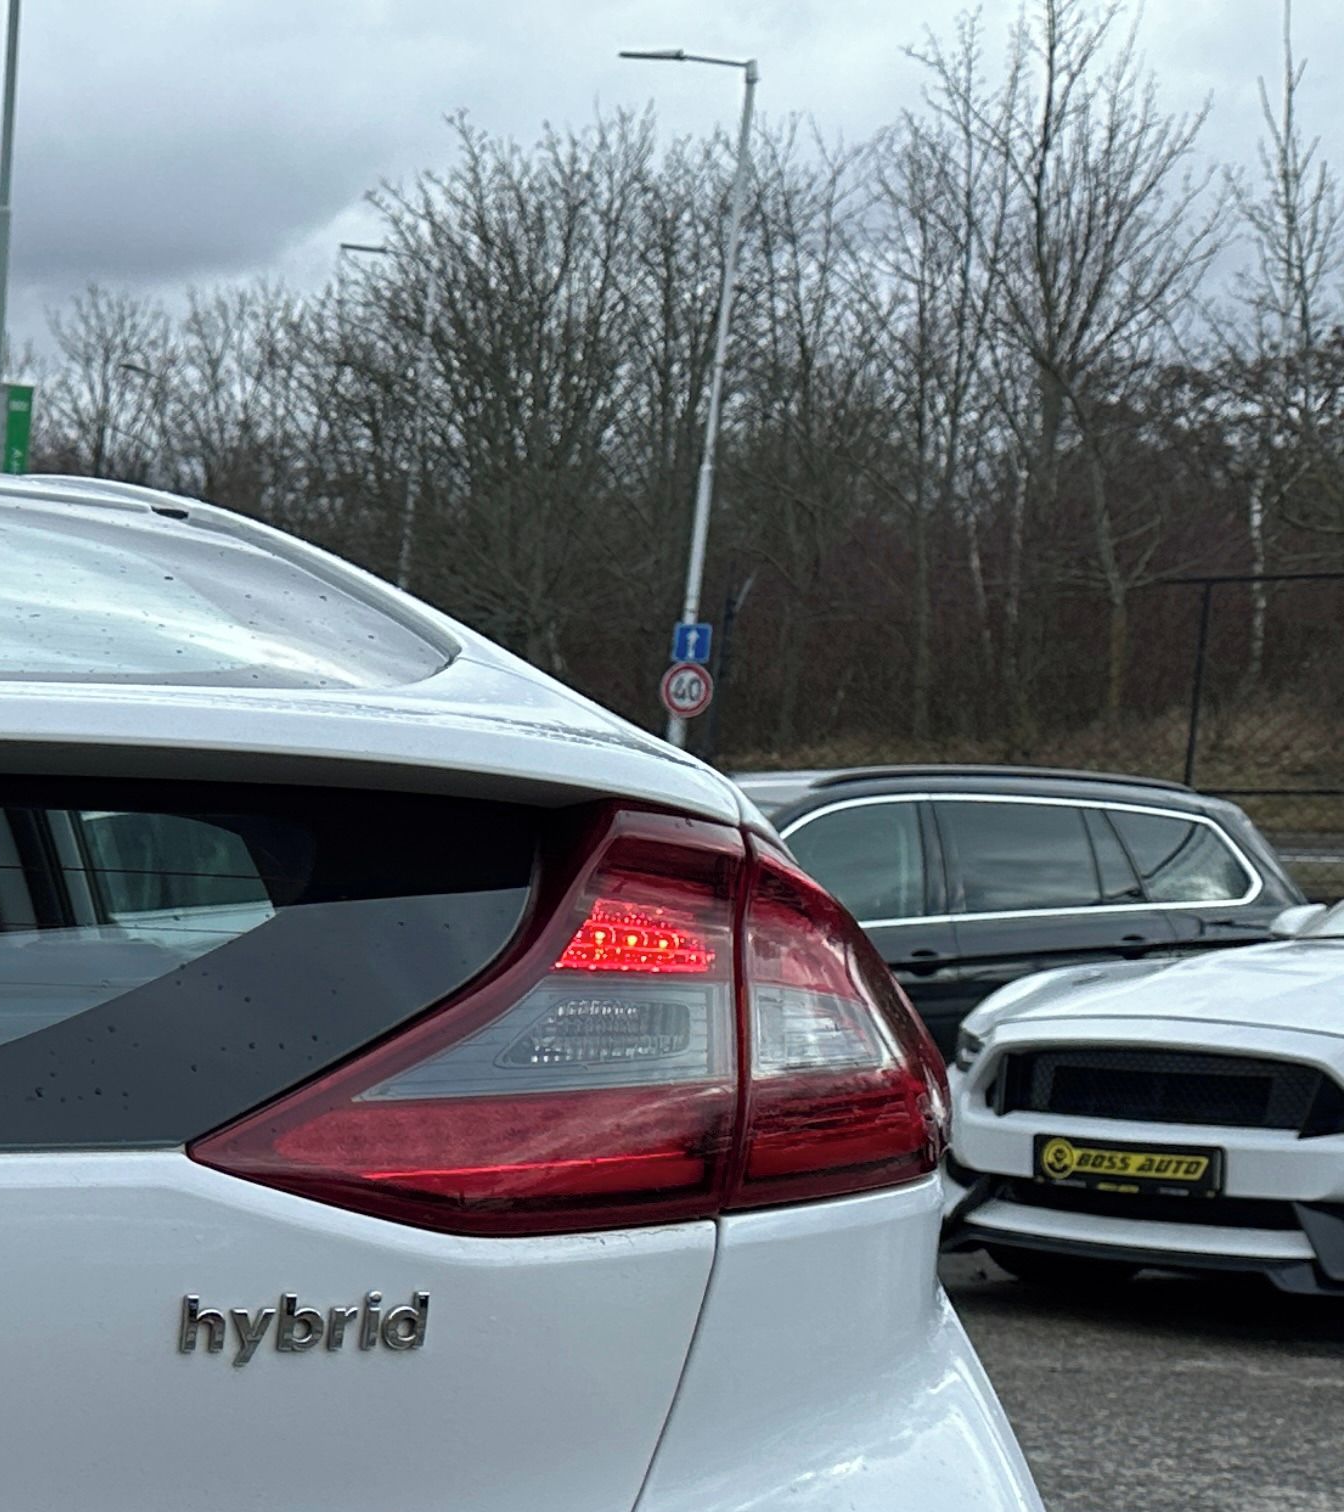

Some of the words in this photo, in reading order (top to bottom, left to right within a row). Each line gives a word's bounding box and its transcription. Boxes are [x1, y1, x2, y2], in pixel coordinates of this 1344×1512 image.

[673, 677, 701, 701] 40
[1077, 1153, 1131, 1170] BOSS
[1136, 1156, 1203, 1175] AUTO
[179, 1289, 431, 1368] hybrid
